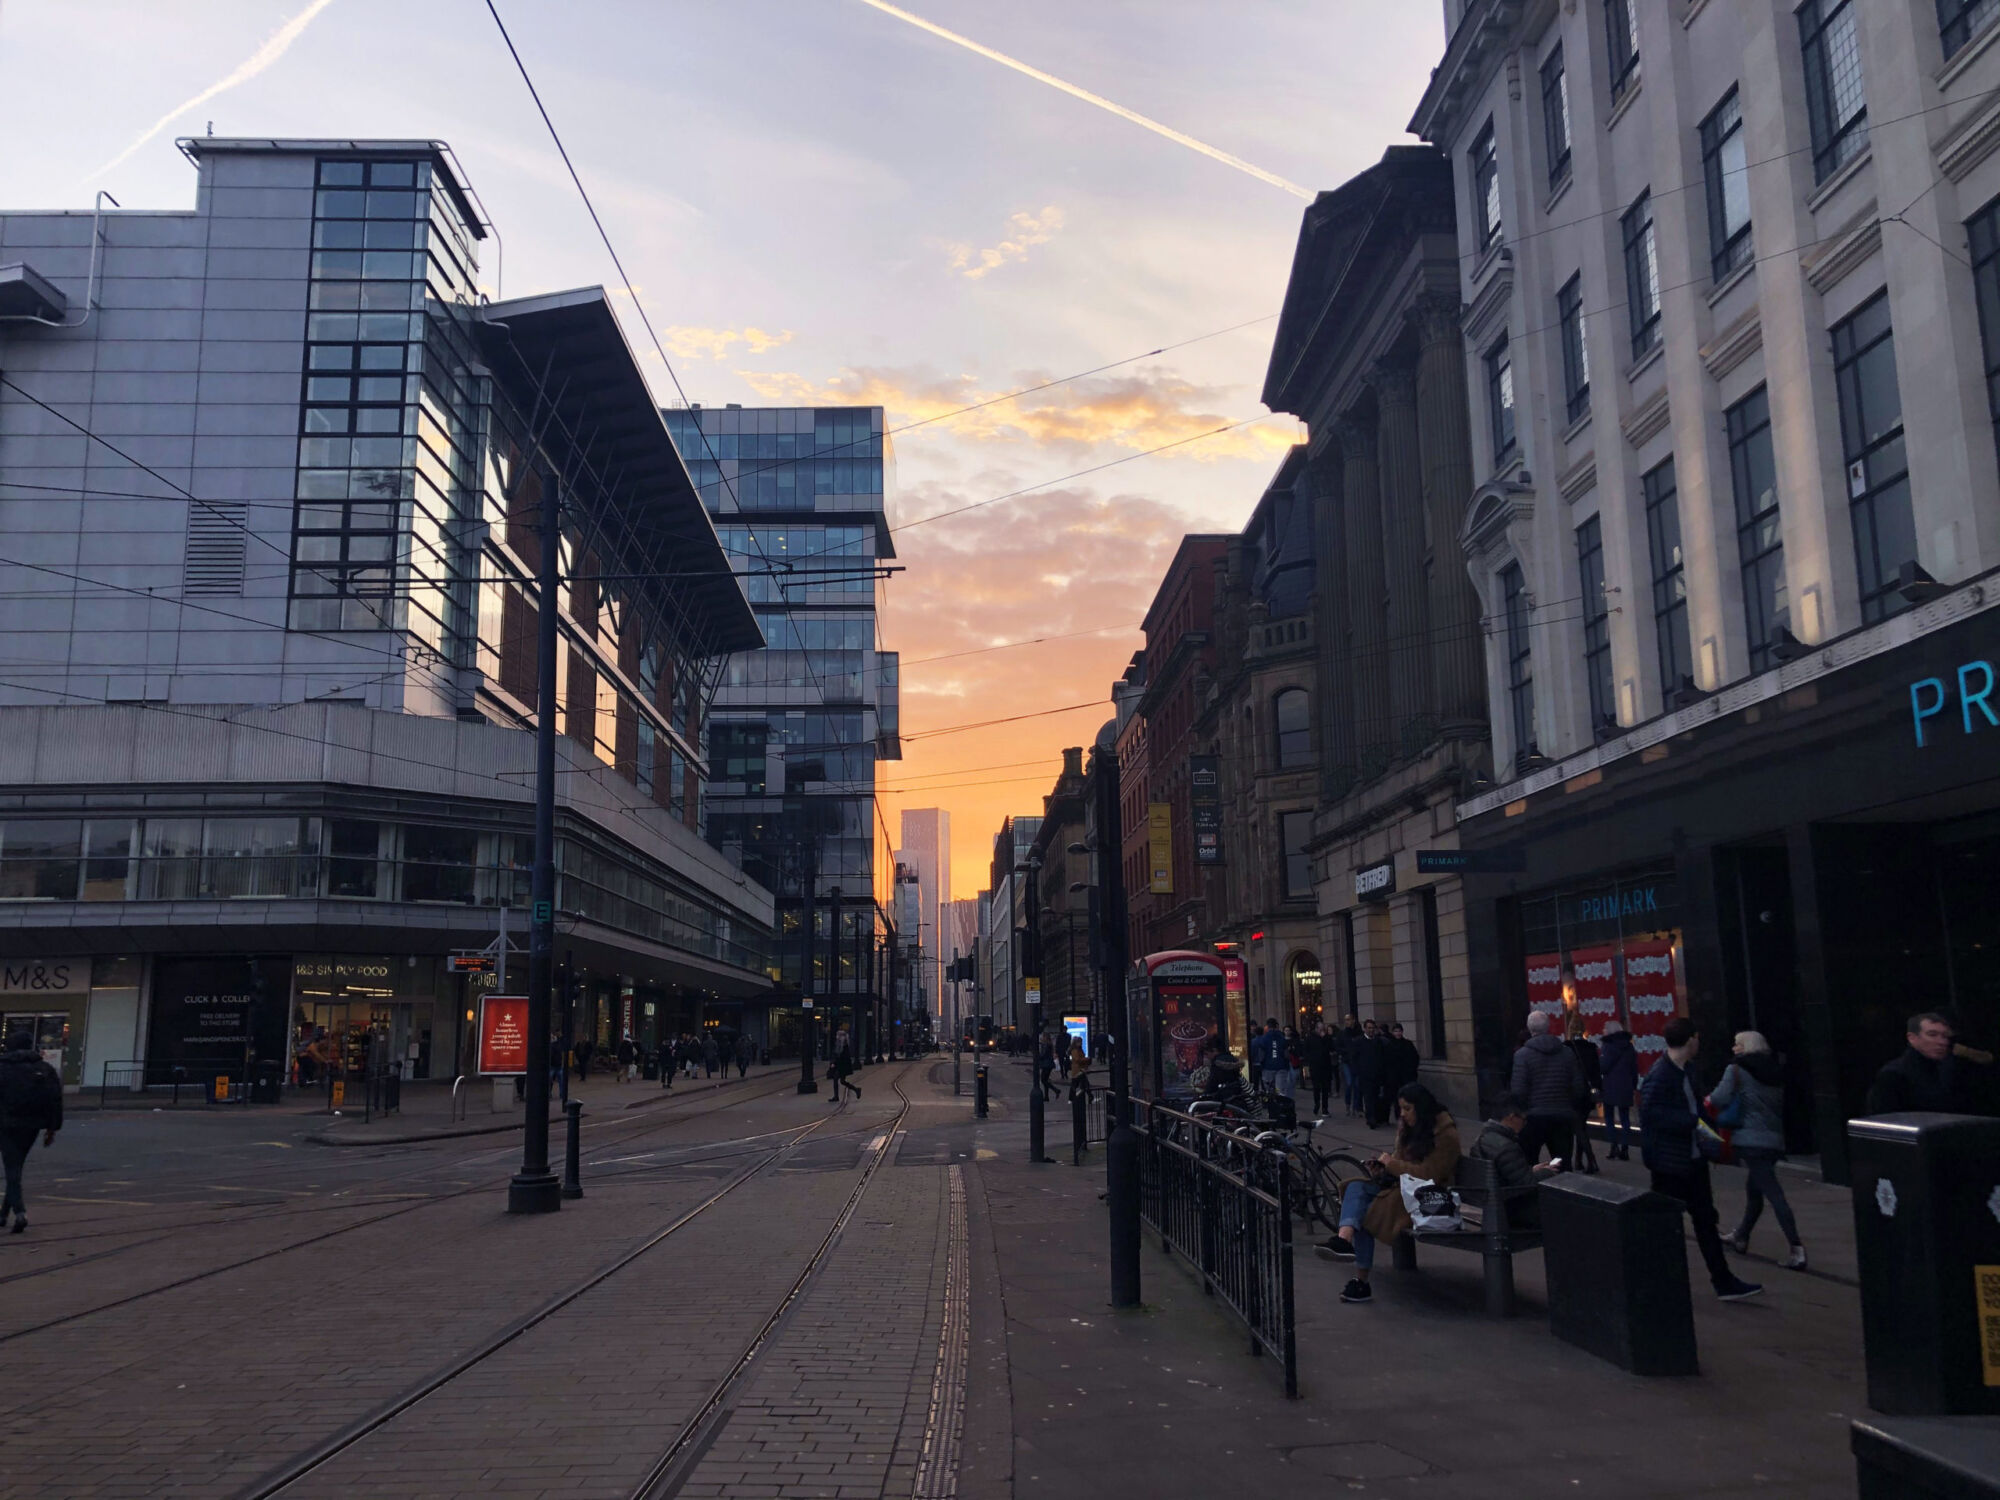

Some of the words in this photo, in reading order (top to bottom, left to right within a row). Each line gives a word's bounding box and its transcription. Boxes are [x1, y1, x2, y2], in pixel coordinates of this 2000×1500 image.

[1199, 847, 1216, 855] Orbit
[1420, 857, 1468, 865] PRIMARK
[1355, 864, 1391, 894] BETFRED
[1581, 887, 1657, 921] PRIMARK
[536, 903, 549, 919] E
[357, 966, 388, 976] FOOD
[1170, 964, 1204, 973] Telephone
[4, 965, 70, 990] M&S
[184, 995, 209, 1004] CLICK
